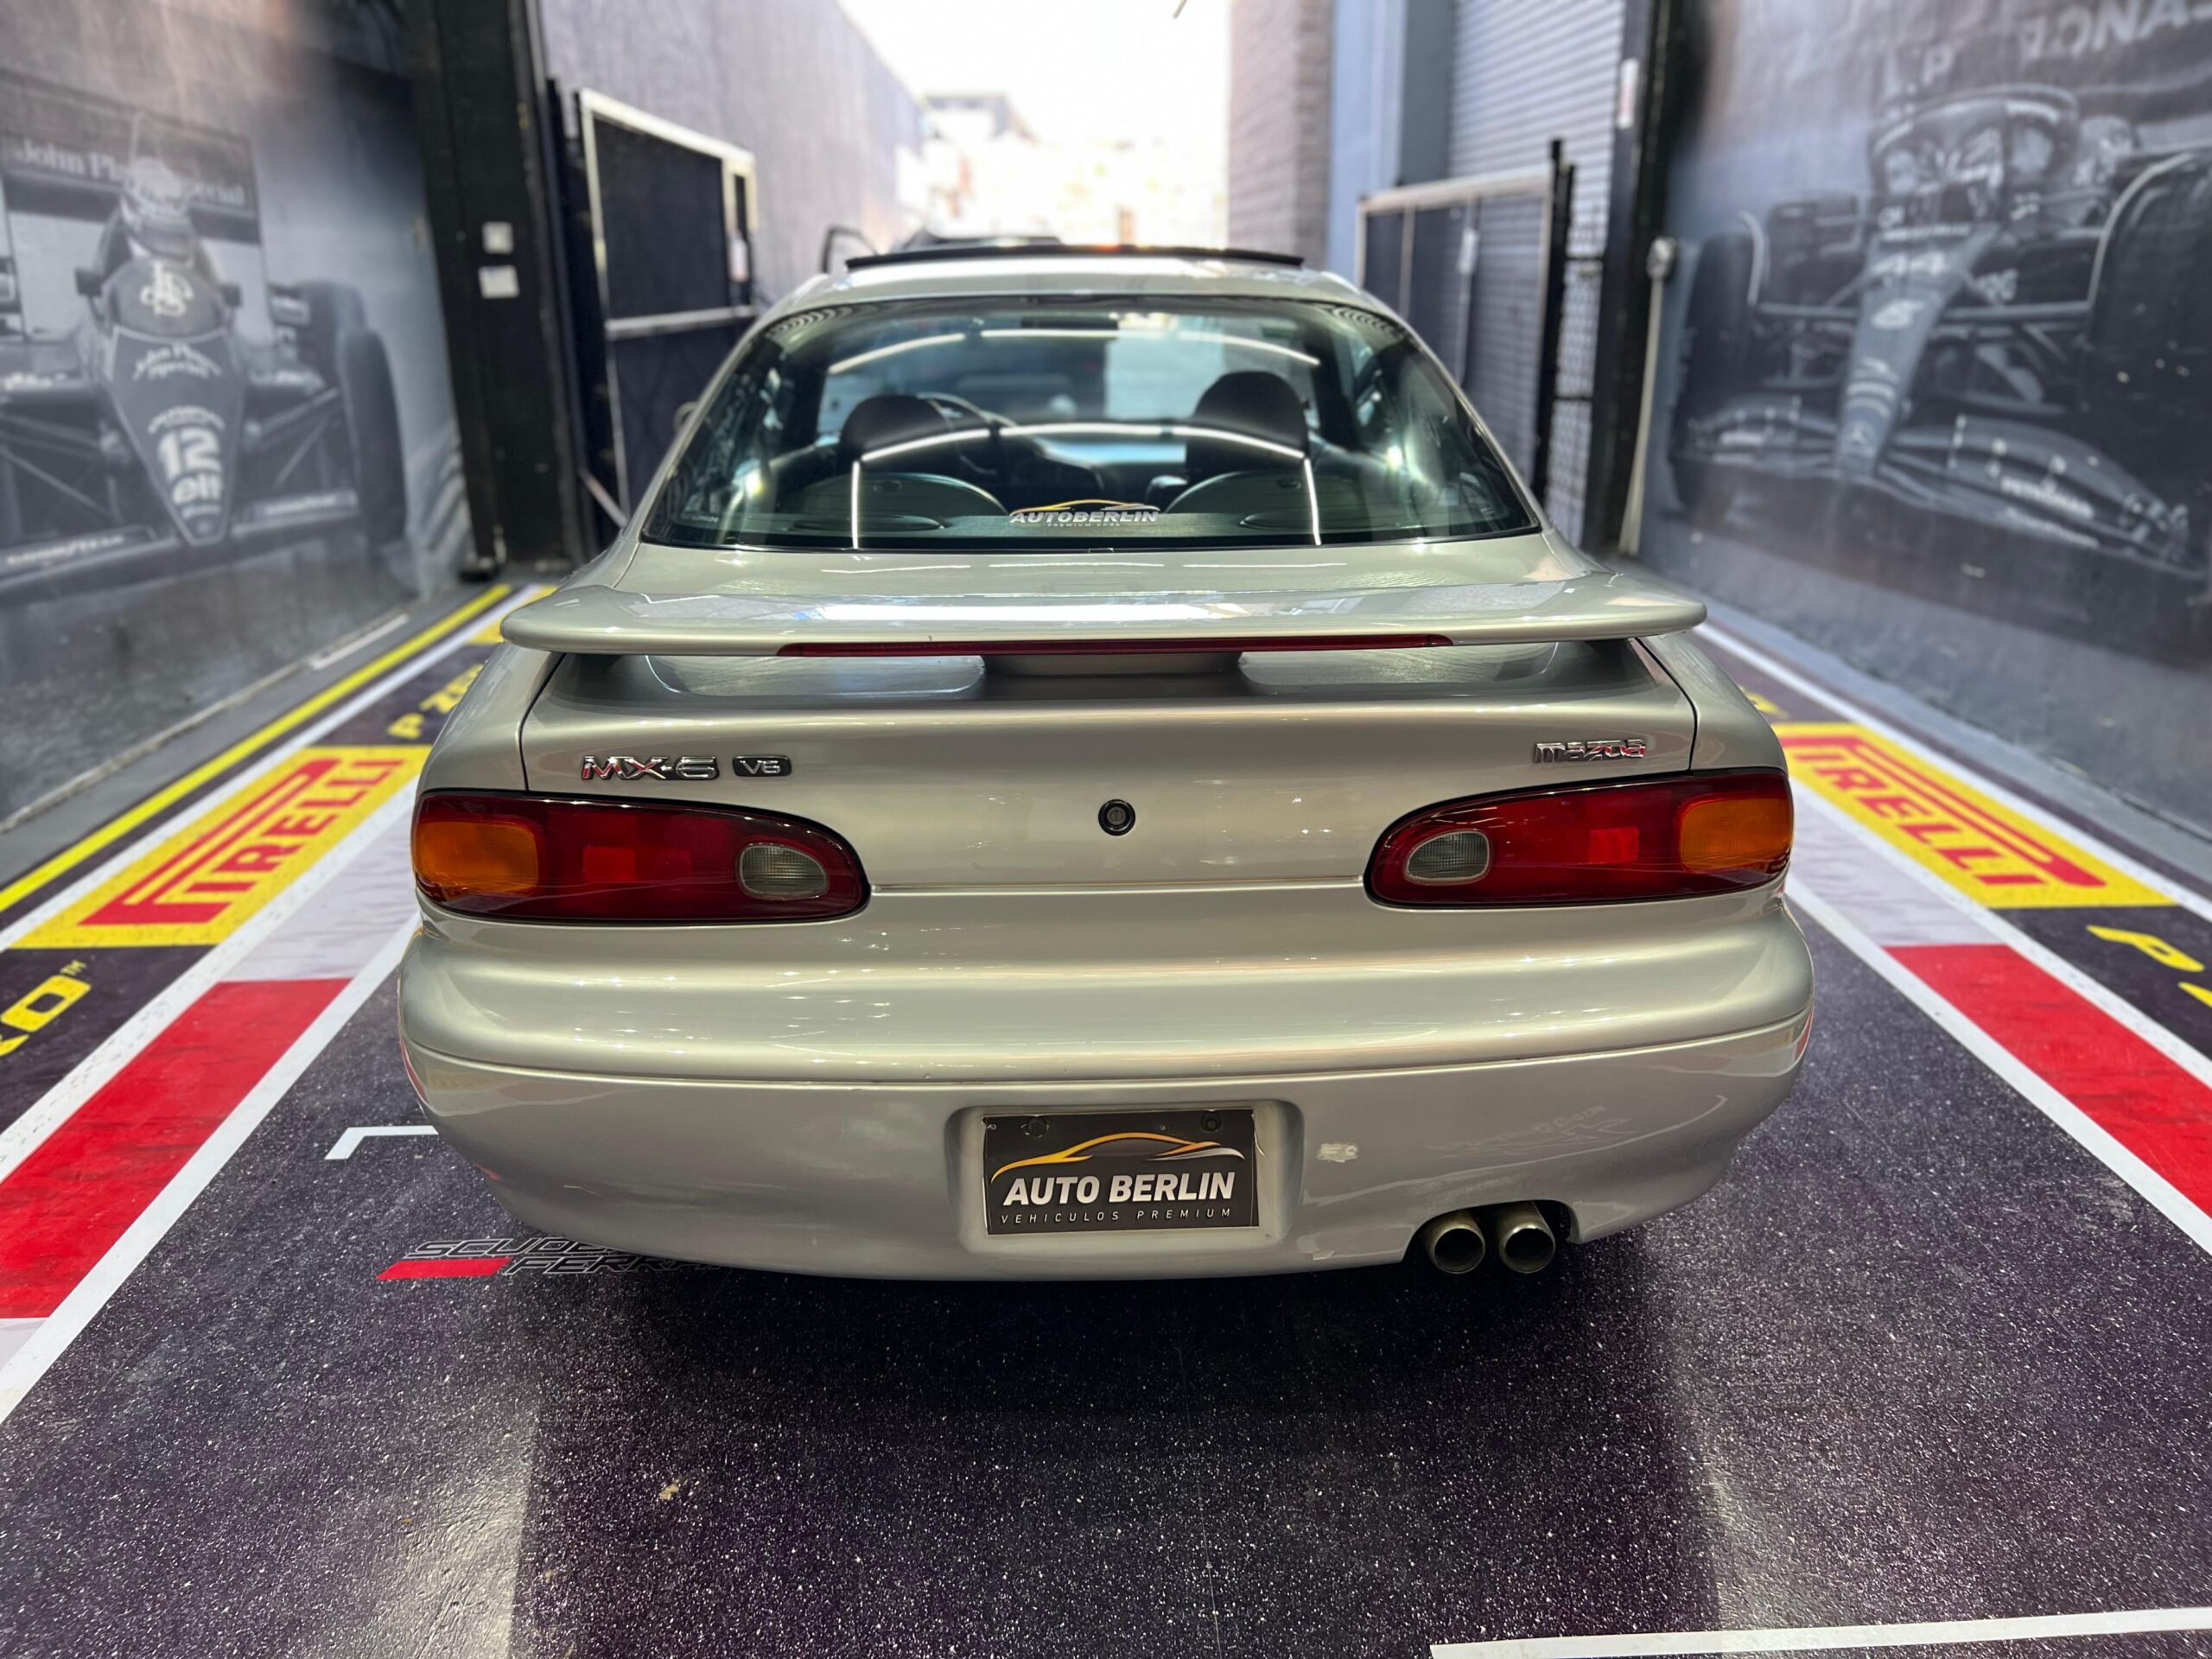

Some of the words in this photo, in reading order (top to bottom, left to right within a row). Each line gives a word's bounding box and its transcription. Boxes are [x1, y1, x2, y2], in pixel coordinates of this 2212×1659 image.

[159, 429, 223, 483] 12
[1009, 511, 1160, 523] AUTOBERLIN
[581, 755, 720, 779] MX-6
[738, 759, 783, 775] V6
[1780, 735, 2107, 887] PIRELLI
[77, 757, 404, 925] PIRELLI
[1002, 1176, 1100, 1206] AUTO
[1108, 1171, 1236, 1204] BERLIN
[1001, 1211, 1120, 1224] VEHICULOS
[1137, 1208, 1231, 1220] PREMIUM
